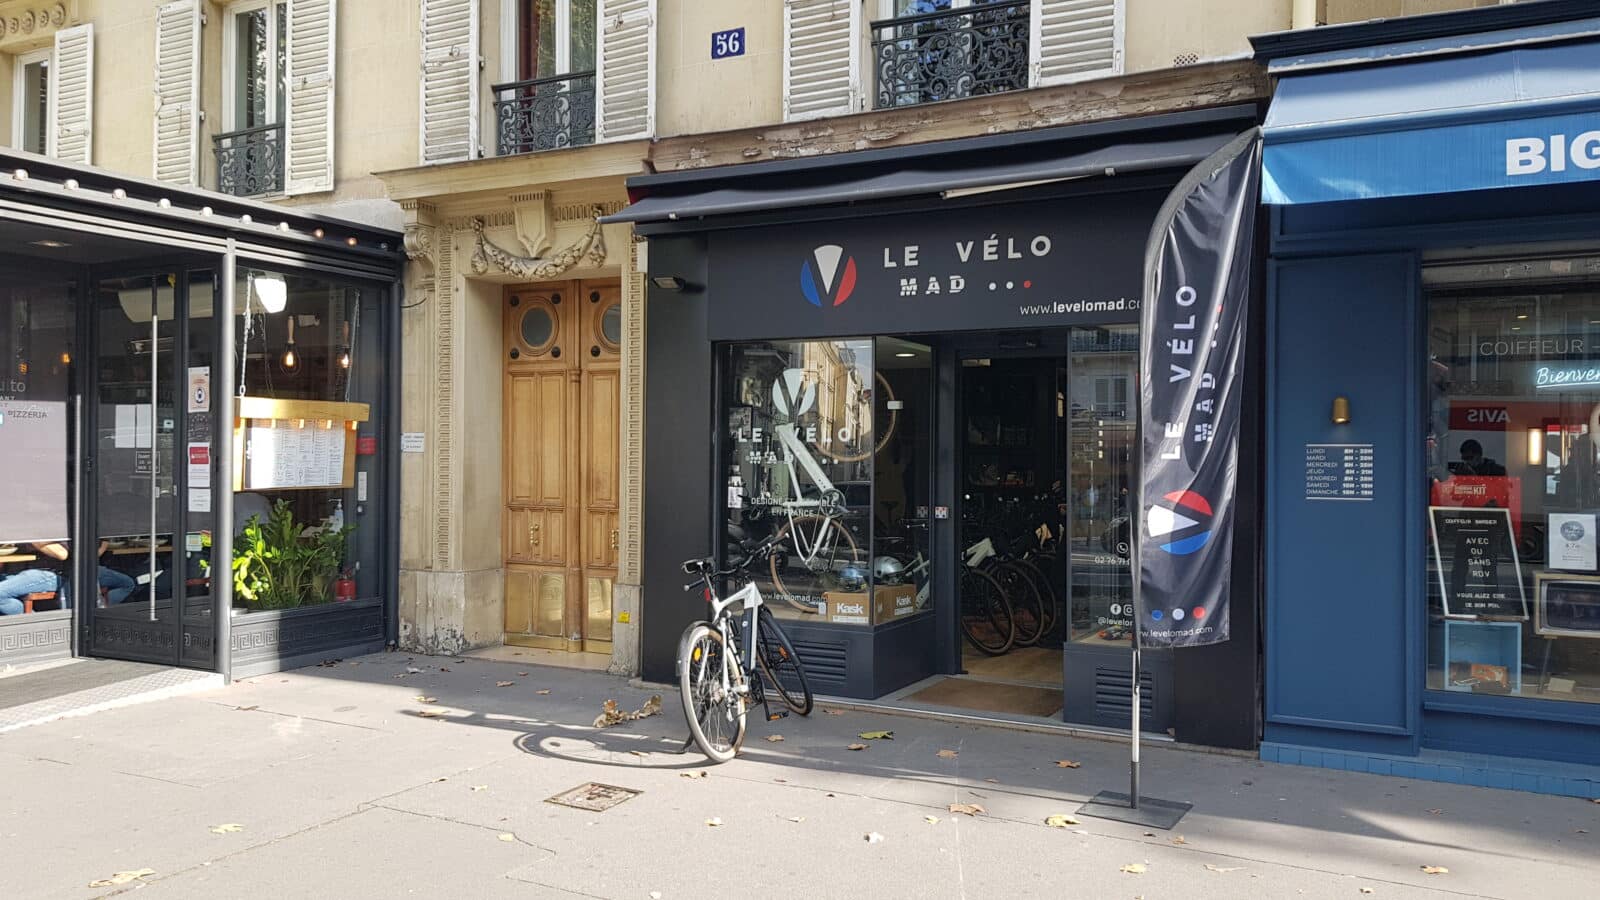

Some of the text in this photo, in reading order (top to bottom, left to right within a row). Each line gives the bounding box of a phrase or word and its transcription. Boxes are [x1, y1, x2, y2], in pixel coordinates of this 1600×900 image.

[716, 32, 740, 56] 56
[1506, 130, 1600, 176] BIG
[884, 233, 1052, 268] LE VÉLO
[900, 275, 965, 297] MAD
[1480, 339, 1584, 356] COIFFEUR
[1161, 285, 1197, 460] LE VÉLO
[1194, 372, 1216, 442] MAD
[738, 427, 763, 443] LE
[836, 602, 864, 614] Kask
[895, 595, 911, 606] Kask
